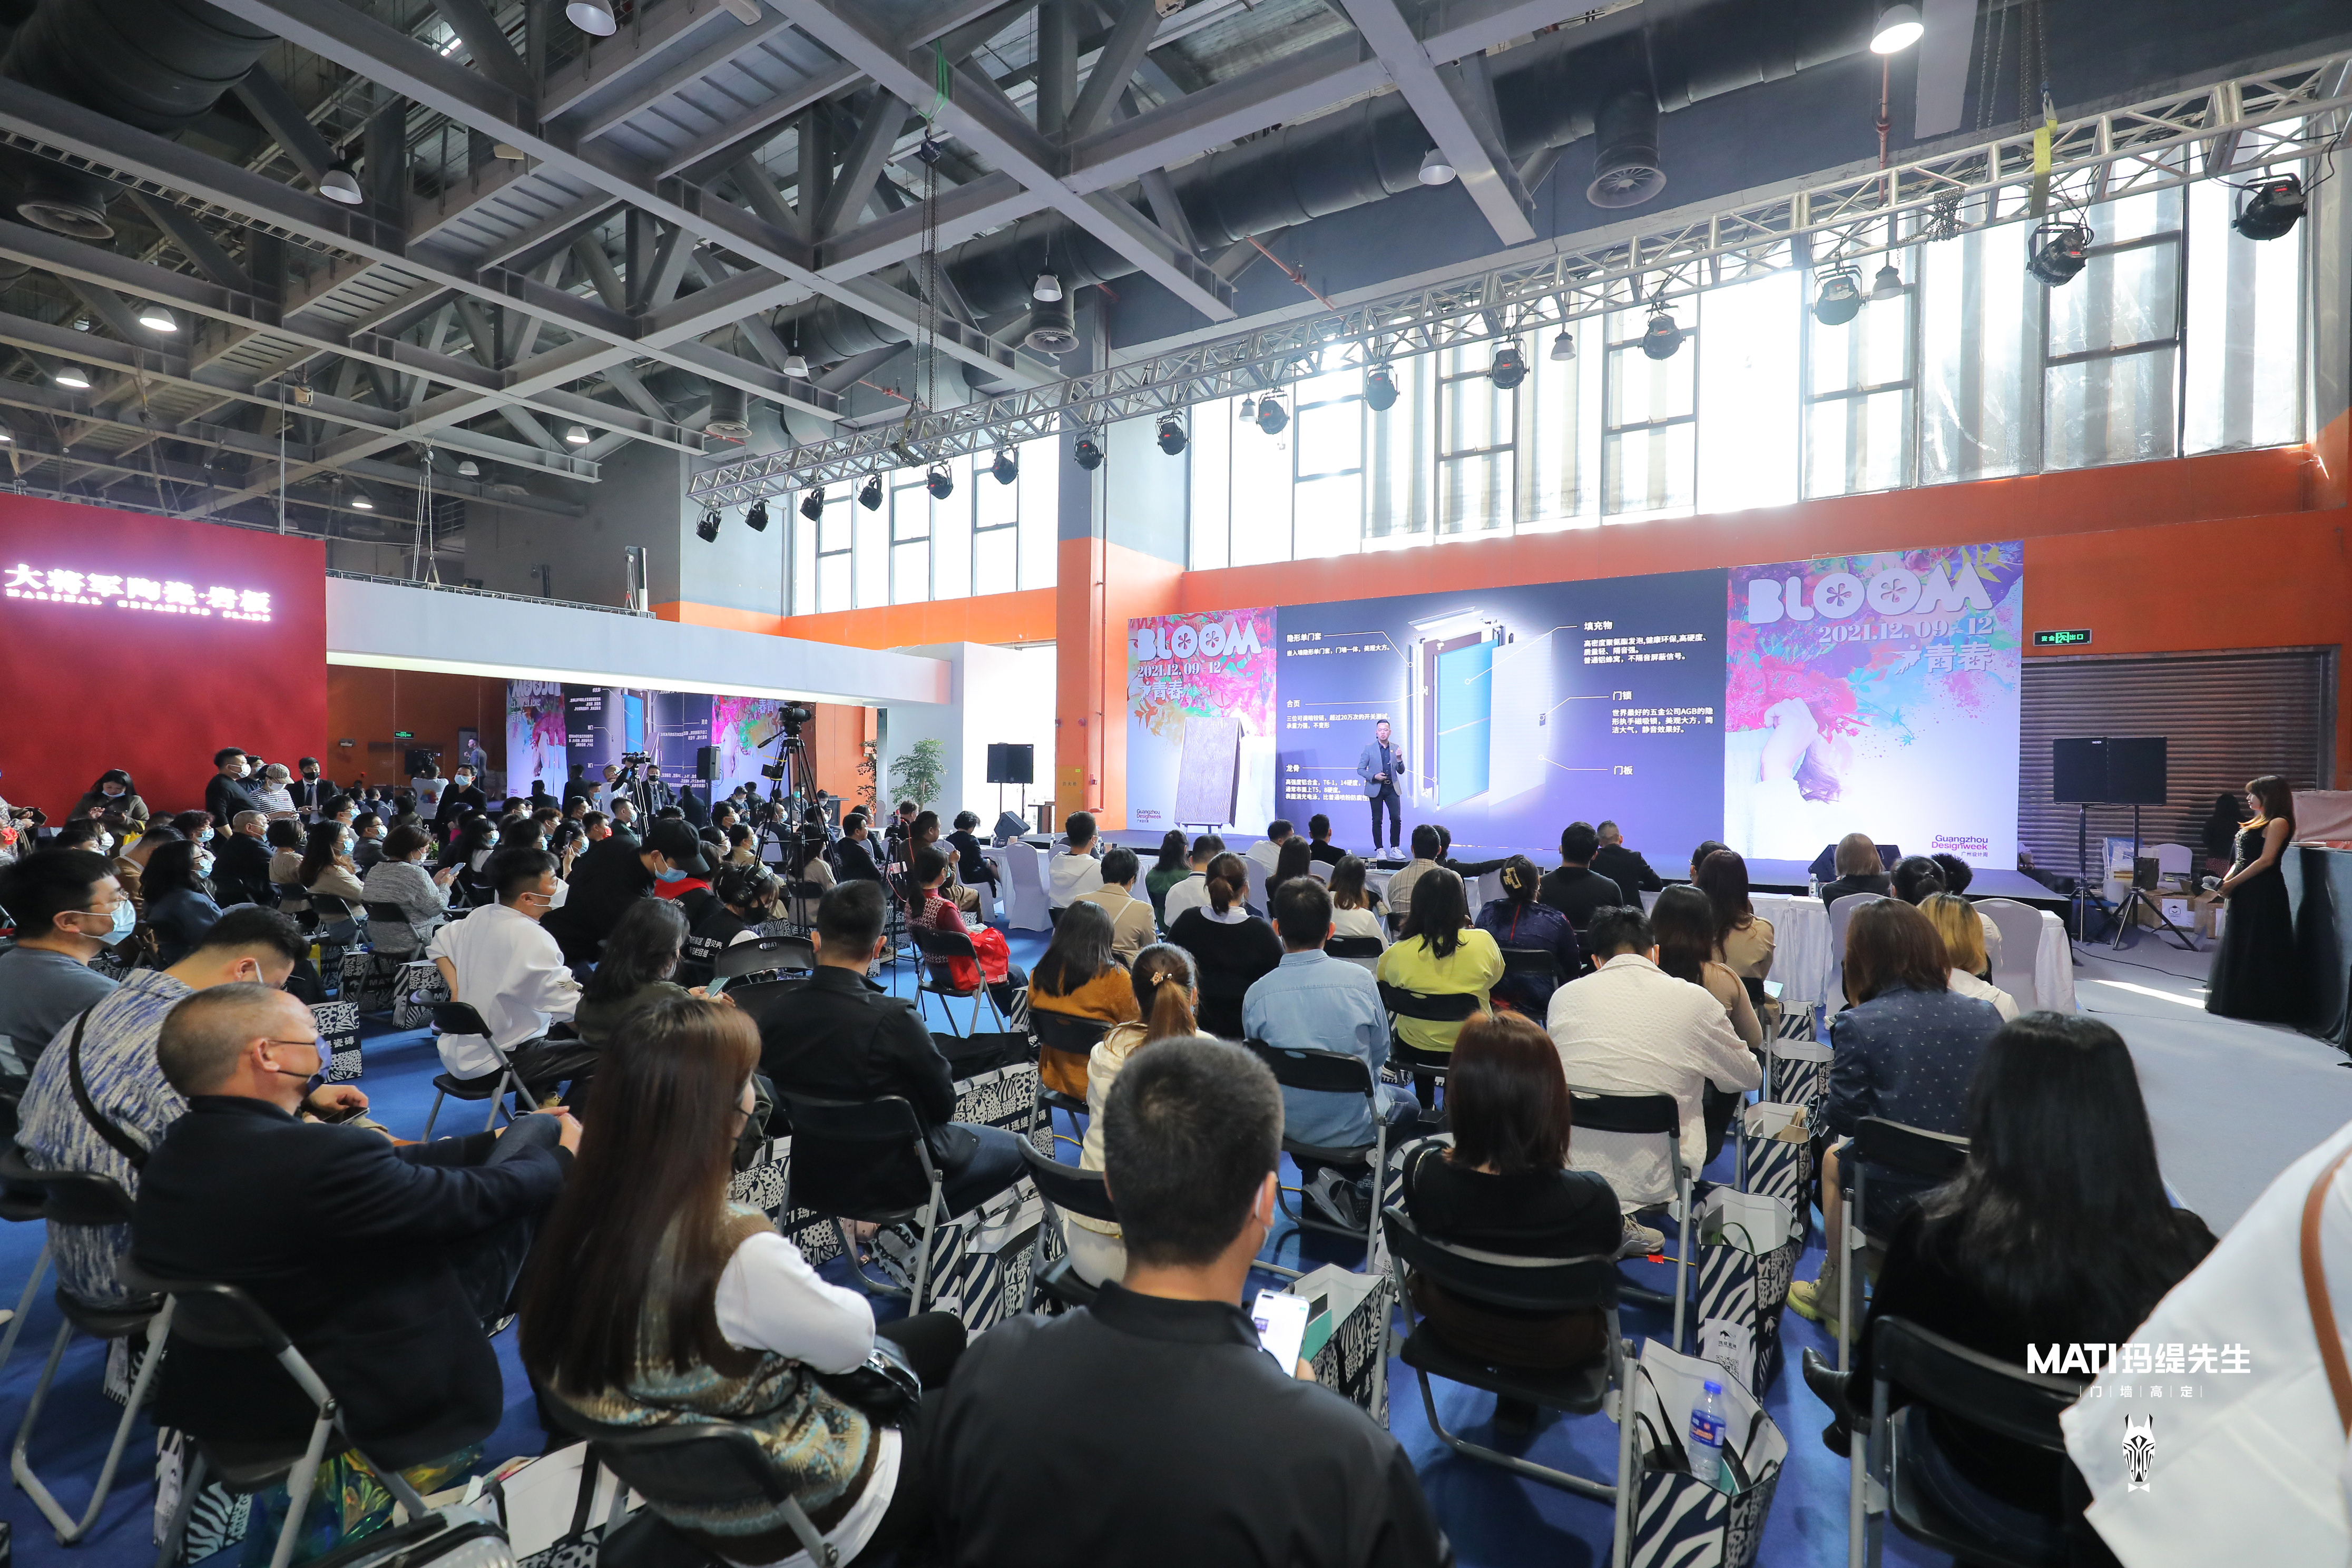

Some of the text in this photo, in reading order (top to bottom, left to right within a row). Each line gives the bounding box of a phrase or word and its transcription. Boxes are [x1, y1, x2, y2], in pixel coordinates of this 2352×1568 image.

[1748, 562, 1993, 624] BLOOM
[1584, 621, 1613, 631] 填充物
[1967, 616, 1993, 635] 12
[1138, 620, 1262, 661] BLOOM
[1287, 632, 1322, 642] 隐形单门套
[1208, 661, 1221, 673] 12
[1612, 691, 1632, 701] 门锁
[1286, 764, 1300, 772] 龙骨
[1613, 766, 1633, 775] 门板
[1935, 835, 1988, 845] Guangzhou
[1932, 841, 1988, 851] Designweek
[710, 939, 723, 949] 贝壳
